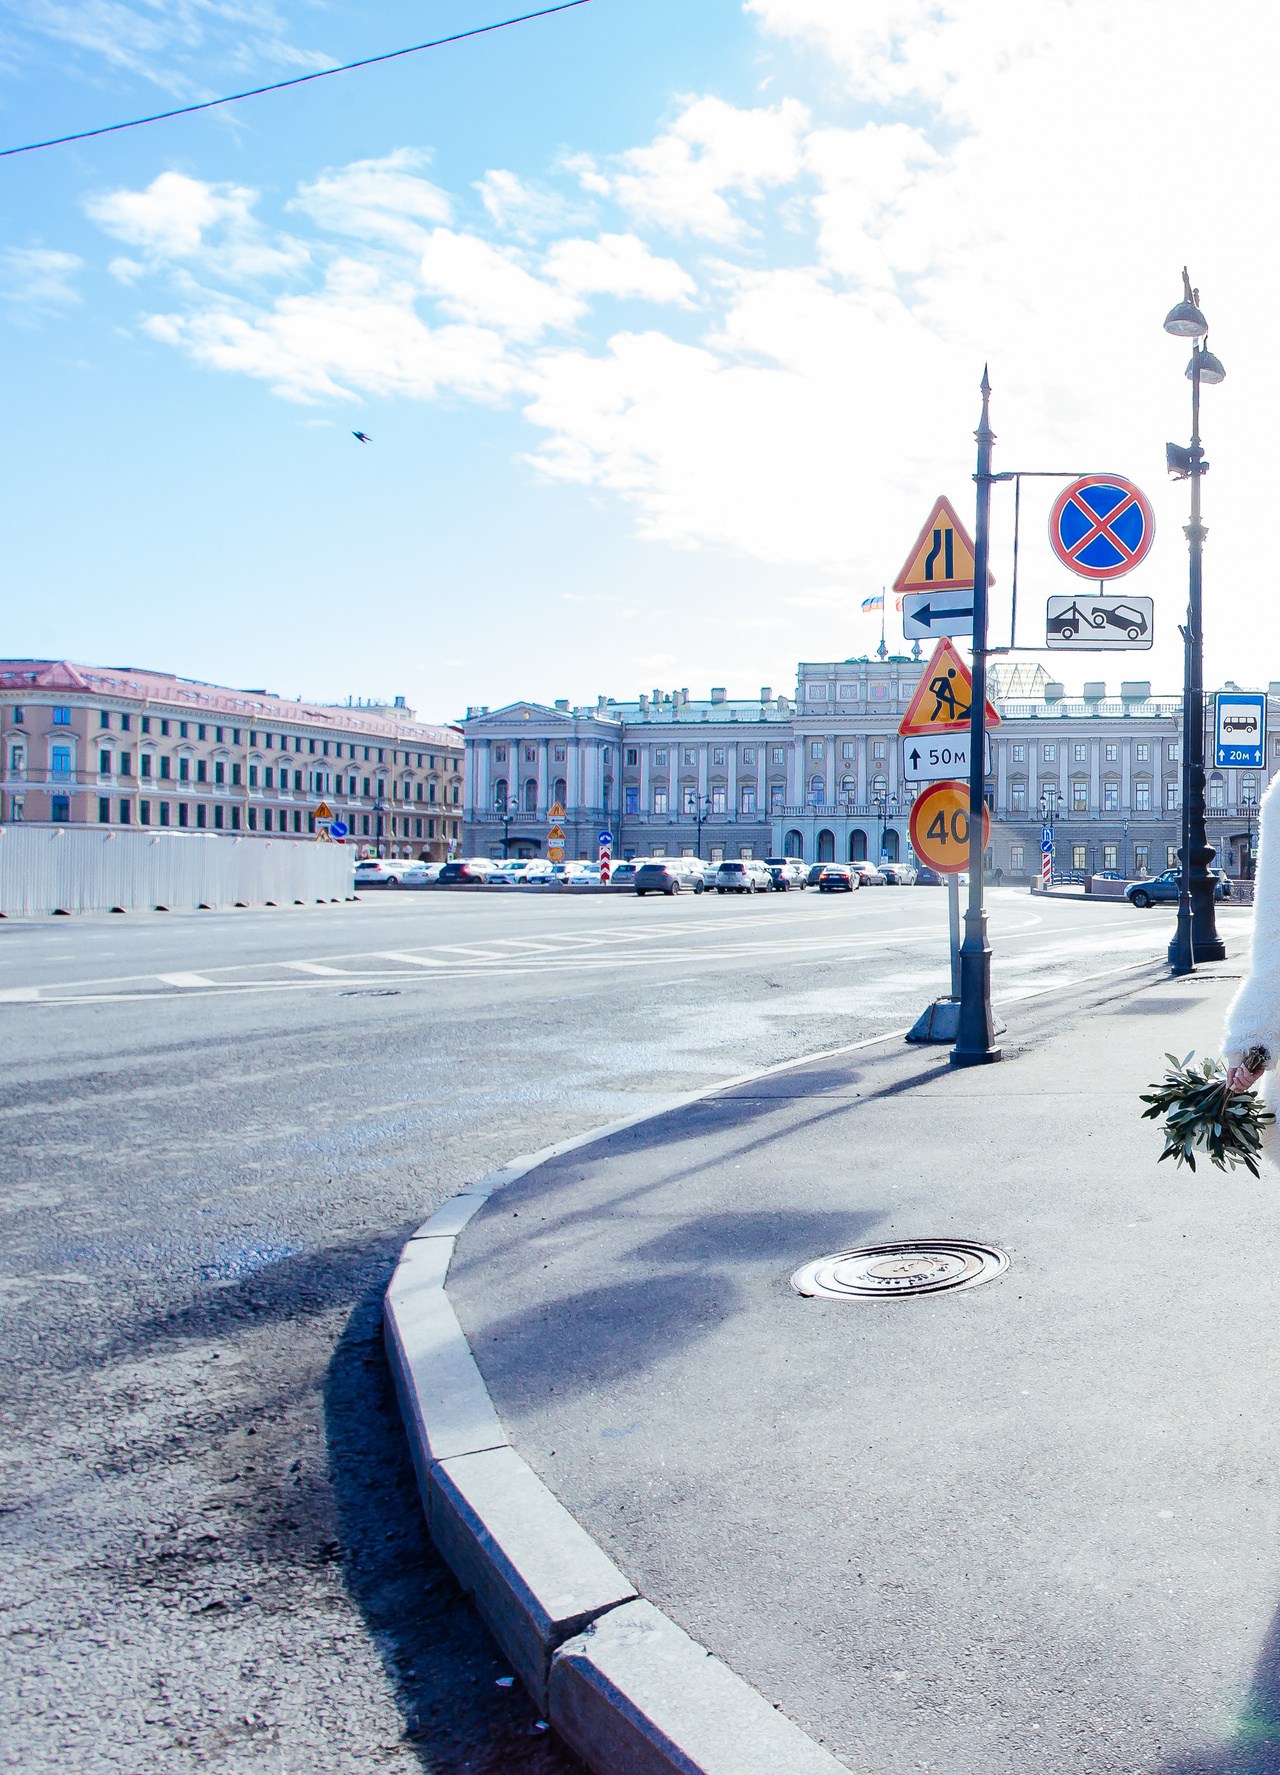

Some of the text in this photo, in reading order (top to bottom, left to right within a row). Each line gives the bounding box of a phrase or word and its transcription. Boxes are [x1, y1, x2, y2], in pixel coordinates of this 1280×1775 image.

[929, 748, 966, 766] 50м
[1229, 750, 1250, 761] 20м
[926, 808, 971, 846] 40
